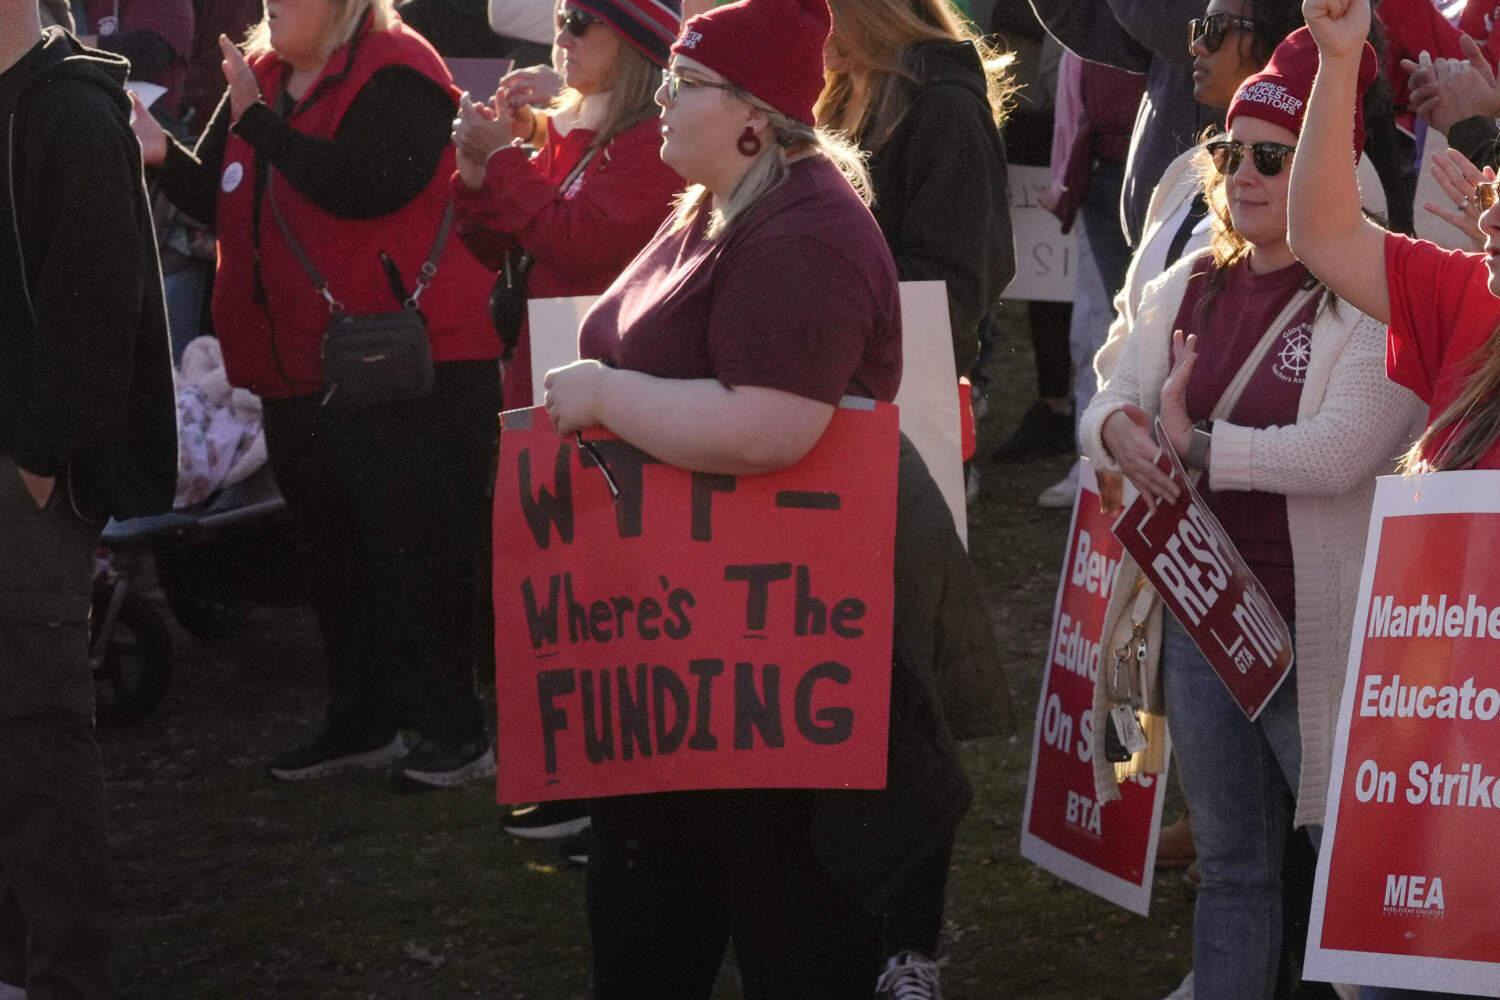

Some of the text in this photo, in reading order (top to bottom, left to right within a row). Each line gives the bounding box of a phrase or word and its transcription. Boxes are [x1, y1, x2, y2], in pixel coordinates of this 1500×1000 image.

[520, 562, 866, 658] Where's The
[1234, 646, 1257, 675] GTA
[537, 658, 854, 774] FUNDING
[1043, 693, 1072, 754] On
[1355, 759, 1397, 804] On
[1065, 790, 1103, 836] BTA
[1383, 874, 1445, 910] MEA
